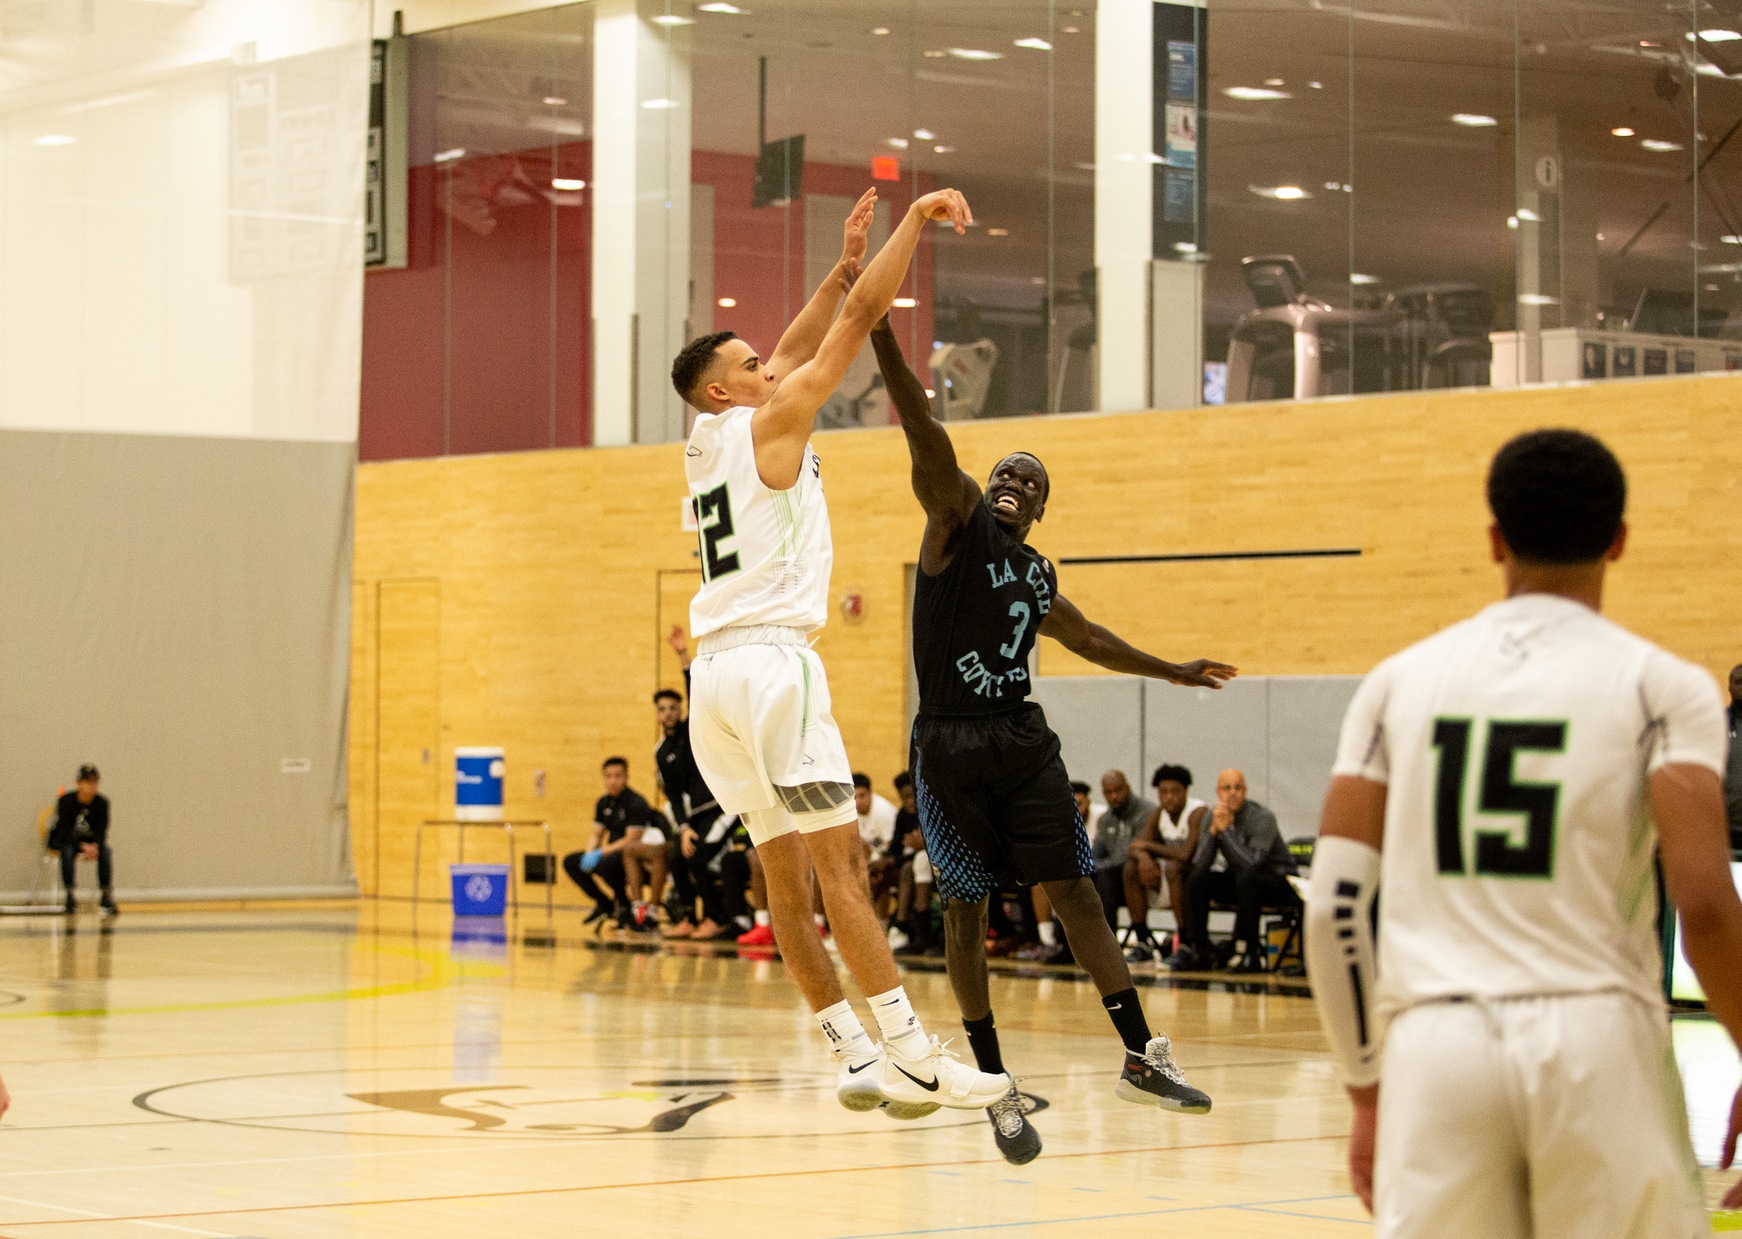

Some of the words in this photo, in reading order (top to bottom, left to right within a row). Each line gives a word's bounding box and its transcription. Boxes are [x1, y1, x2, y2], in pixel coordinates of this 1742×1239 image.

[986, 558, 1018, 589] LA
[1000, 601, 1031, 660] 3
[1432, 716, 1569, 880] 15
